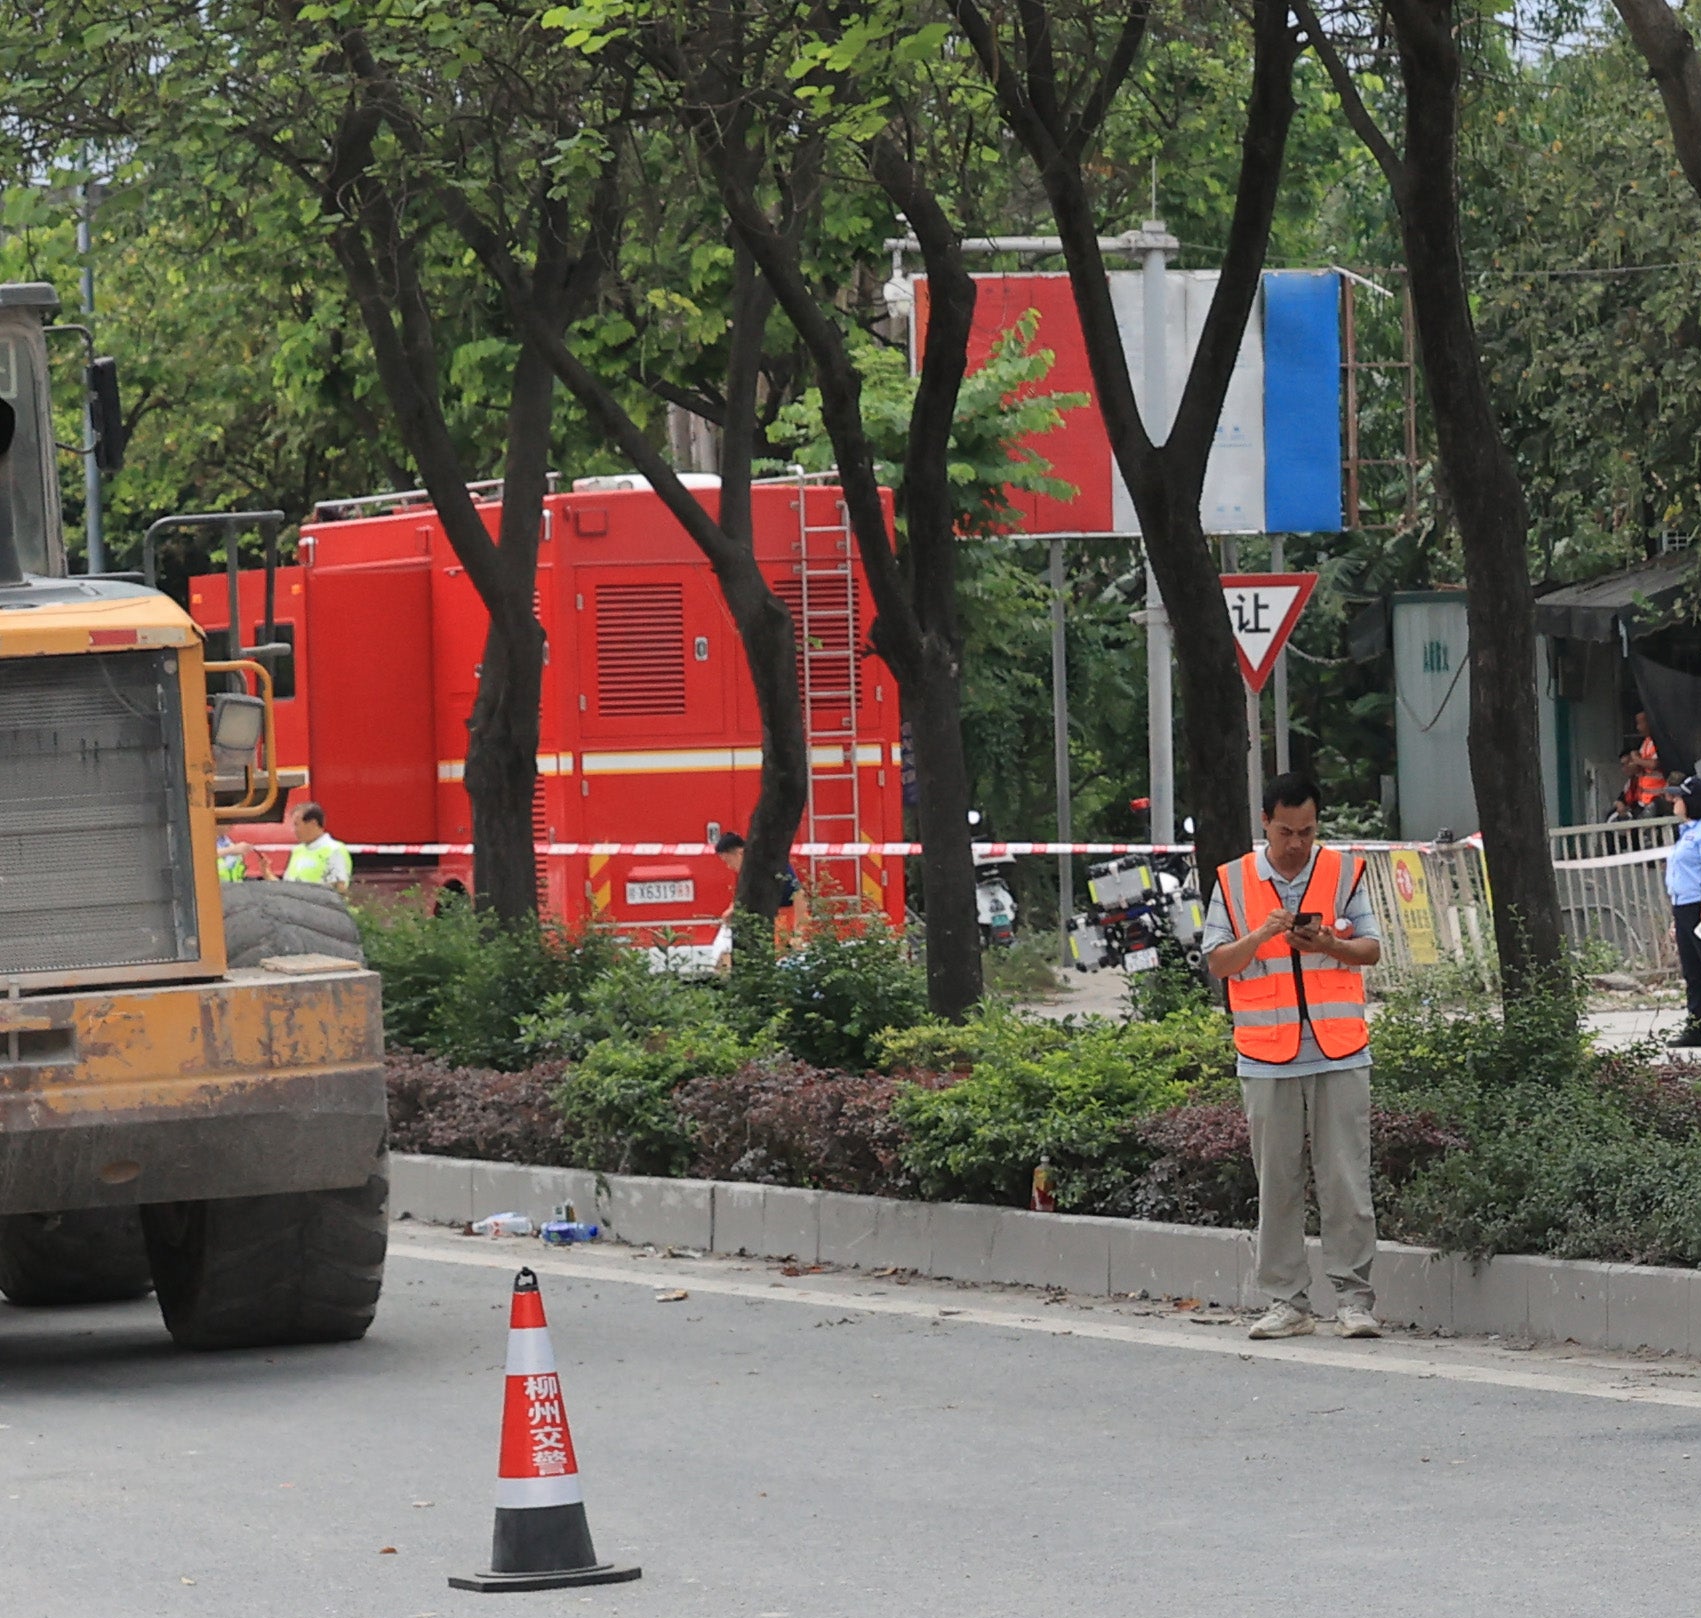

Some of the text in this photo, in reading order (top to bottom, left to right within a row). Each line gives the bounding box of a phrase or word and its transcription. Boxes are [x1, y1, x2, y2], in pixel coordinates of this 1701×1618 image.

[1232, 592, 1271, 633] 让
[523, 1375, 567, 1476] 柳州交警
